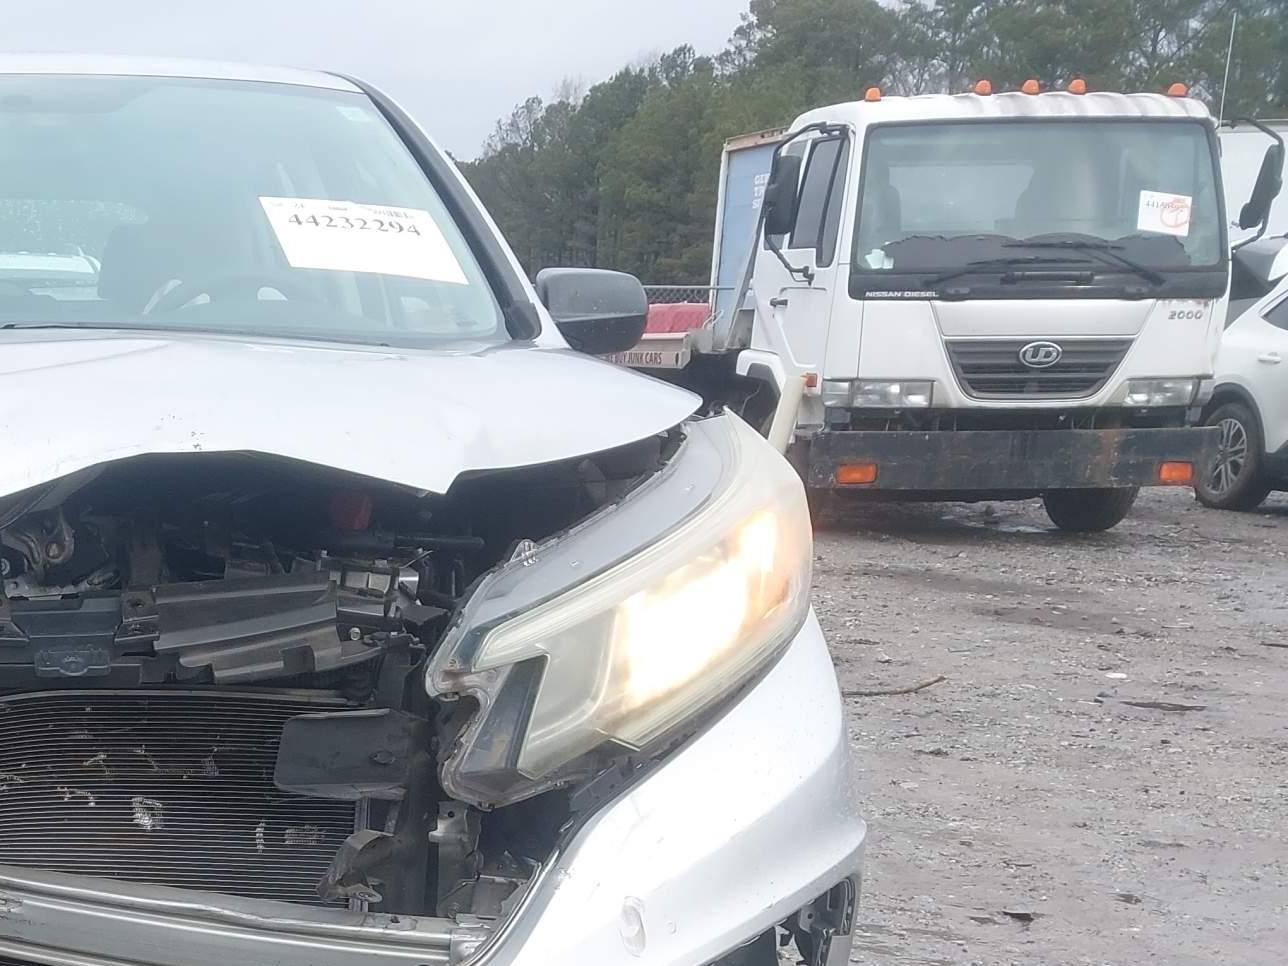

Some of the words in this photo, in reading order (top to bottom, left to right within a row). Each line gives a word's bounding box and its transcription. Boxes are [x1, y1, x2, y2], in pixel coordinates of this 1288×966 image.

[288, 213, 421, 236] 44232294
[864, 290, 902, 298] NISSAN
[903, 290, 940, 298] DIESEL
[1167, 309, 1204, 321] 2000
[628, 351, 644, 364] JUNK
[645, 351, 662, 365] CARS
